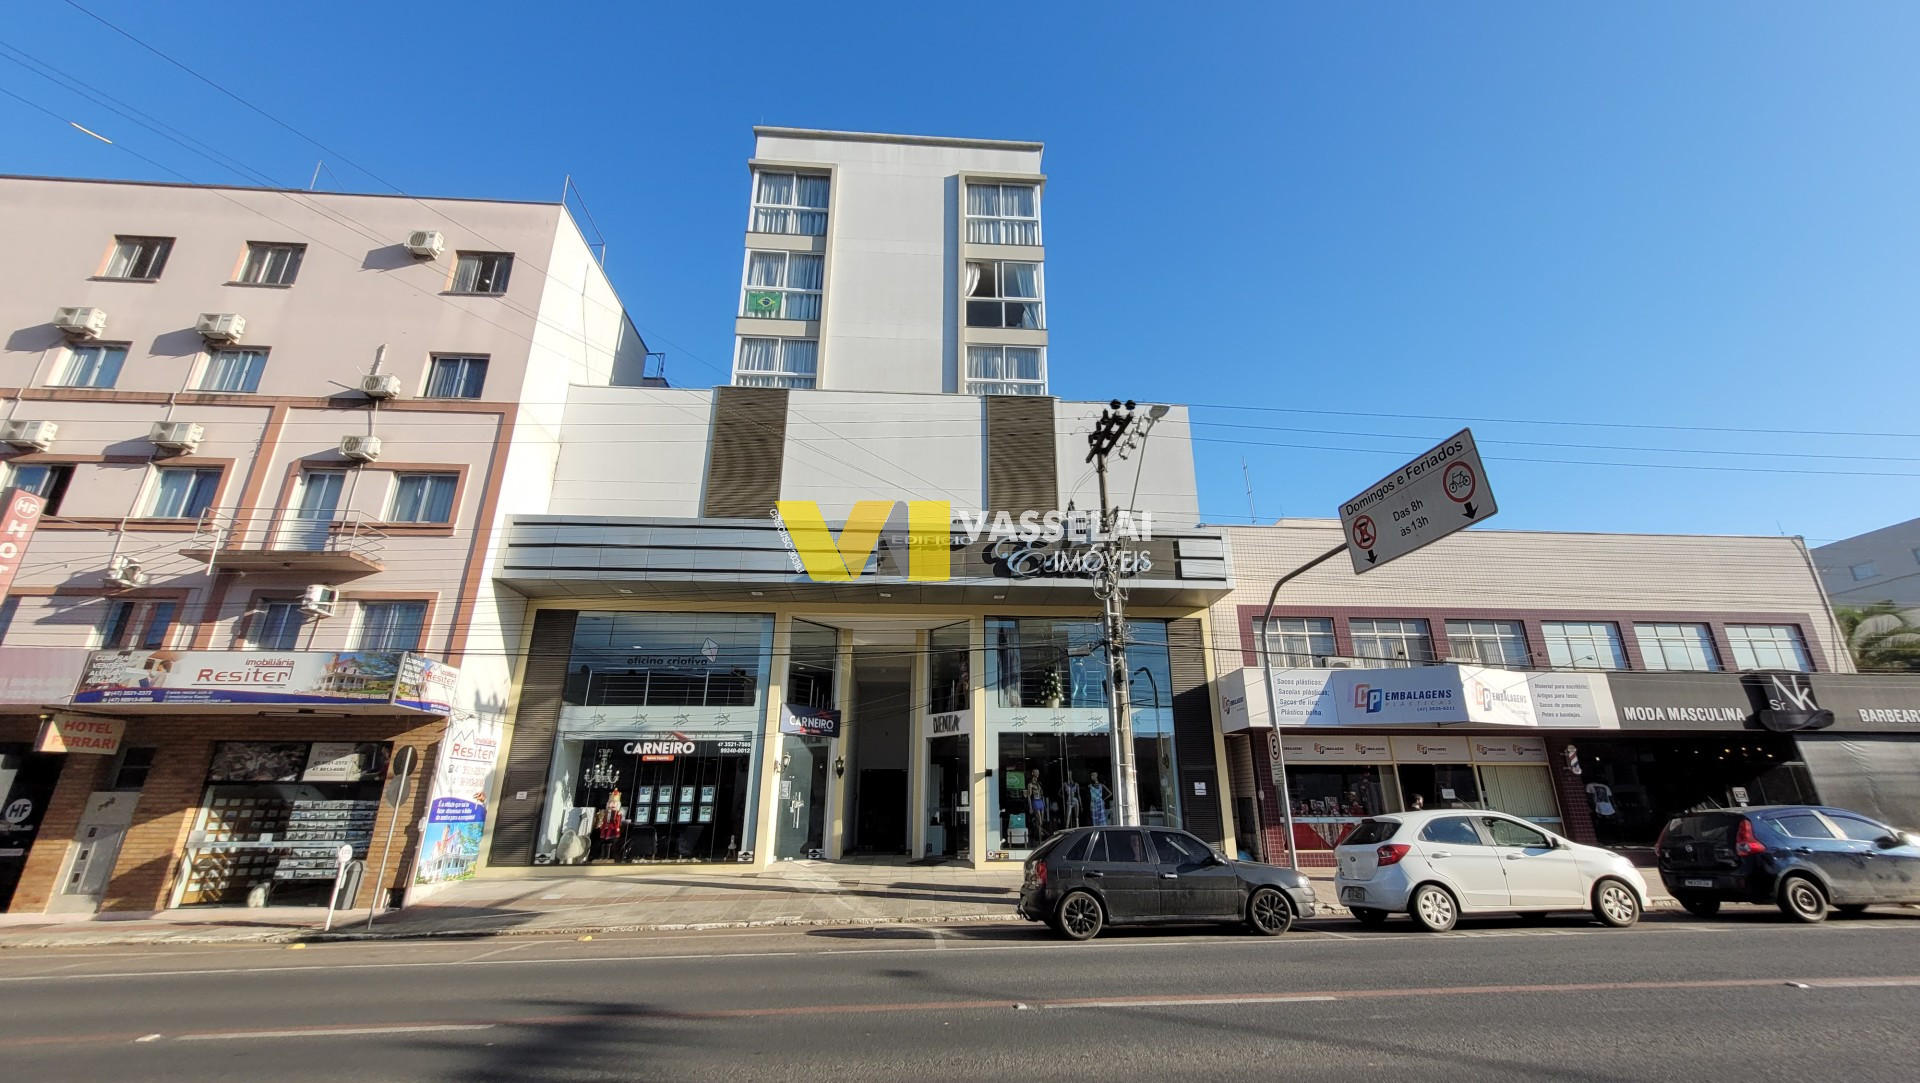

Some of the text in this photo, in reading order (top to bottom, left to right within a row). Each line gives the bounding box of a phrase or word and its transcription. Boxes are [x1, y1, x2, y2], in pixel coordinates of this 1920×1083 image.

[1345, 440, 1463, 516] Domingos e Feriados
[17, 500, 37, 514] HF
[1392, 499, 1424, 522] Das 8h
[1411, 515, 1429, 531] 13h
[246, 657, 295, 666] imobiliária
[627, 656, 708, 666] oficina criativa
[197, 668, 289, 683] Resiter
[1385, 689, 1452, 701] EMBALAGENS
[1492, 692, 1528, 703] EMBALAGENS
[1770, 699, 1790, 711] Sr.
[1623, 706, 1746, 722] MODA MASCULINA
[62, 721, 113, 735] HOTEL
[789, 715, 835, 730] CARNEIRO
[51, 735, 118, 750] FERRARI
[623, 742, 696, 755] CARNEIRO
[452, 743, 494, 760] Resiter
